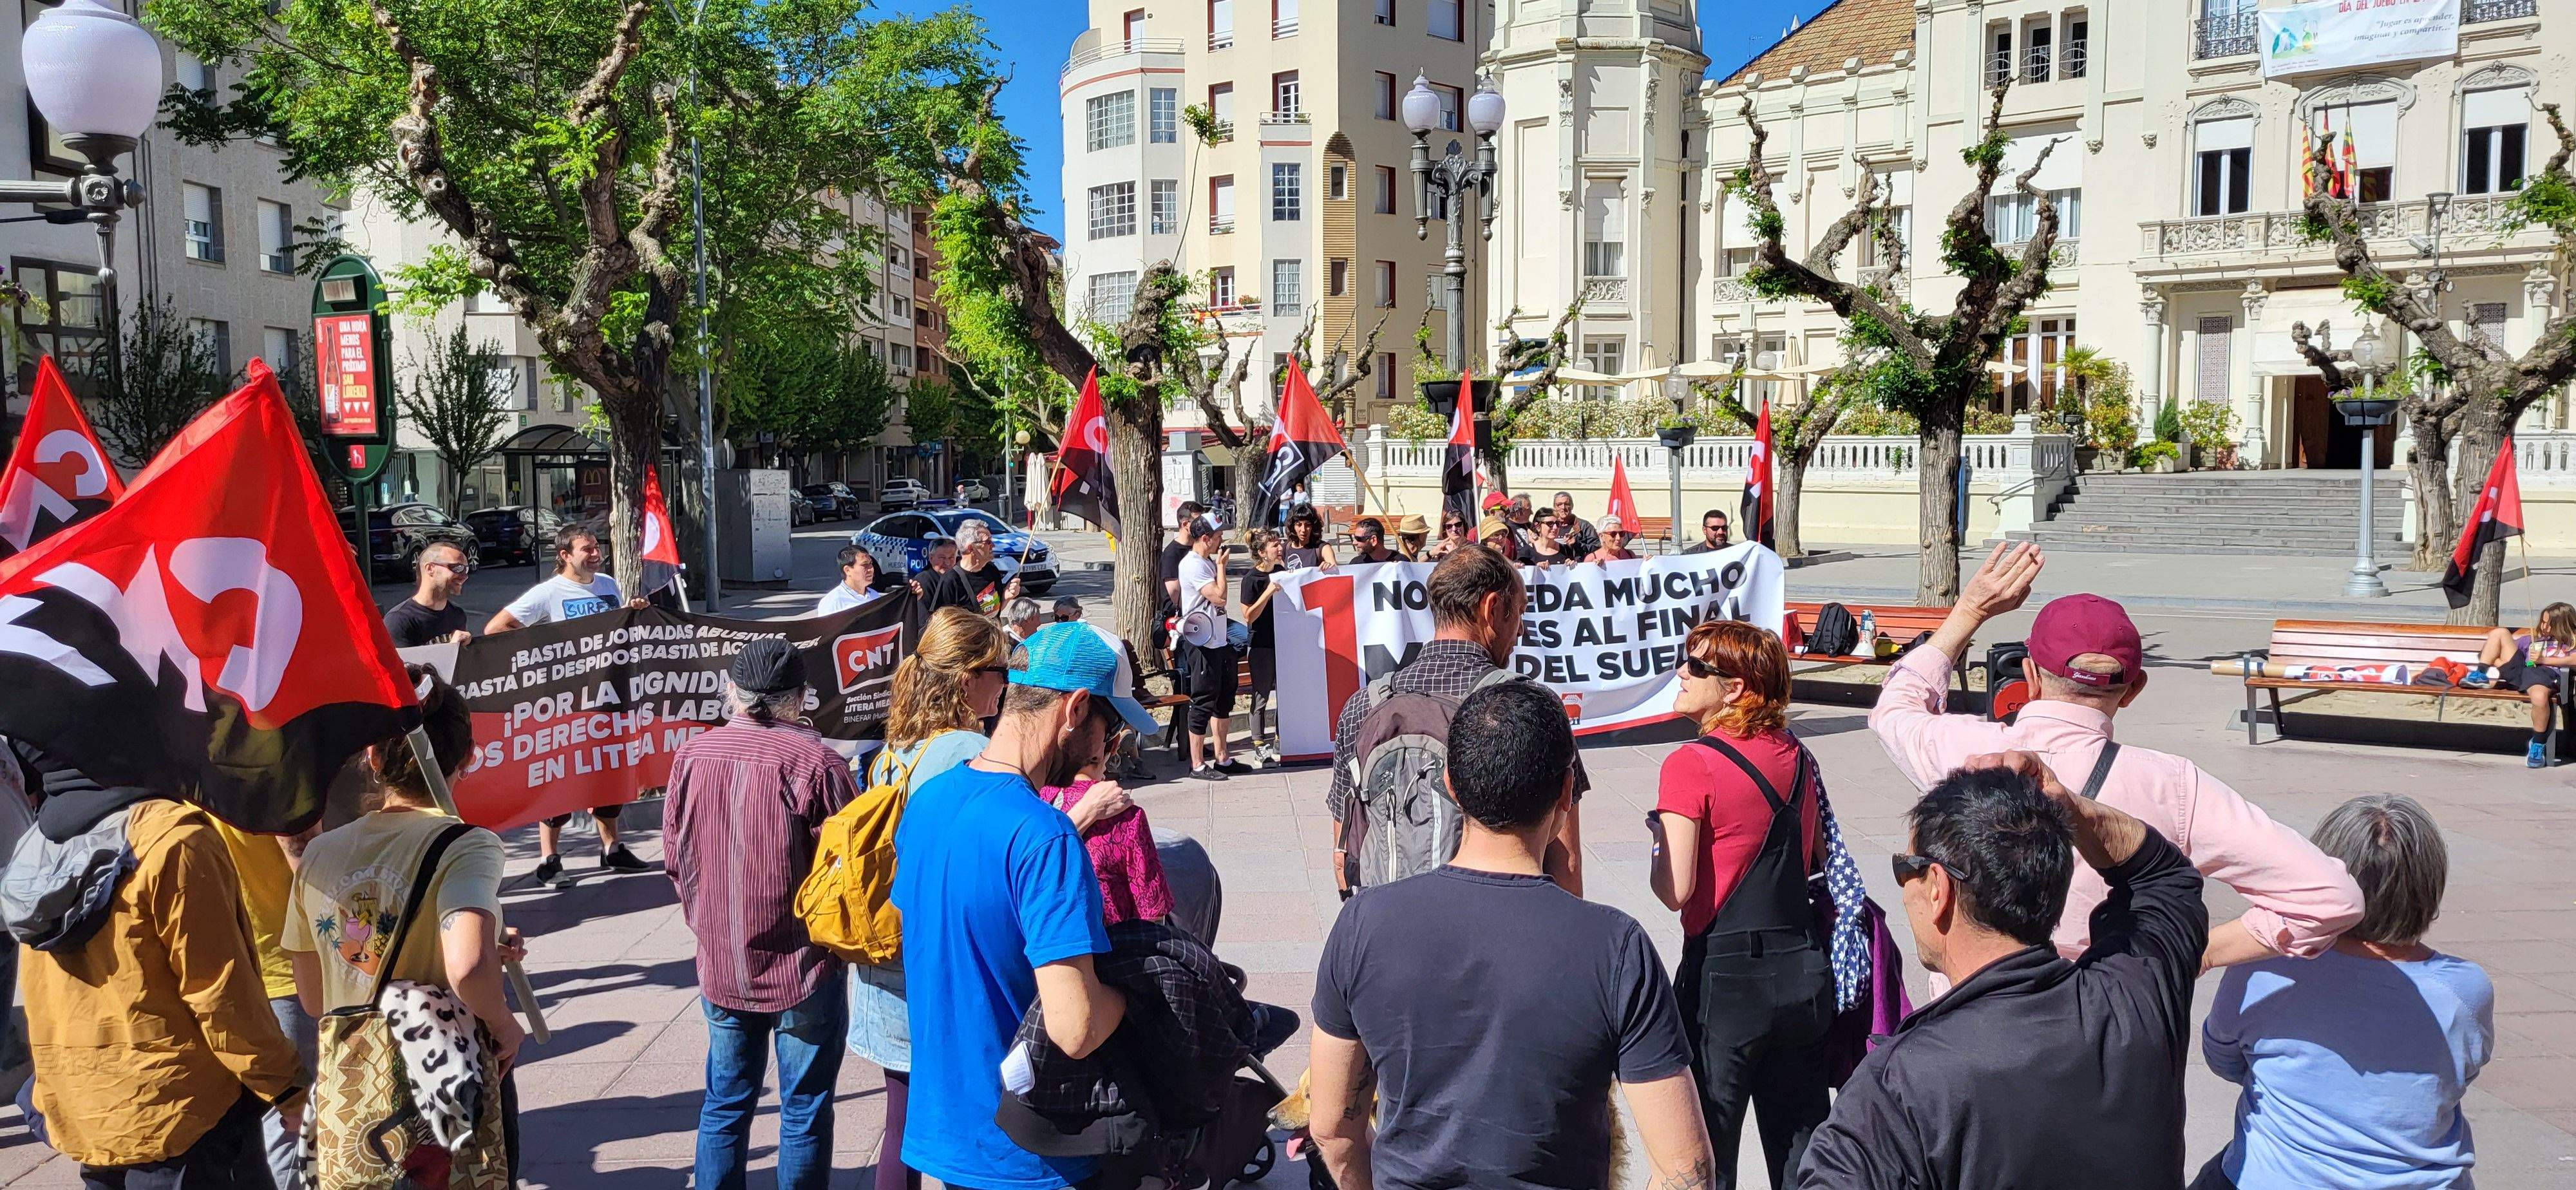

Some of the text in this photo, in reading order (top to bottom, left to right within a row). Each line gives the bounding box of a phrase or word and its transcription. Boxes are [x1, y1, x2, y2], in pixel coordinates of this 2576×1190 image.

[2339, 3, 2351, 13] DÍA
[2356, 1, 2369, 10] DEL
[339, 319, 367, 332] UNA HORA
[340, 334, 359, 346] MENOS
[341, 347, 364, 359] PARA EL
[342, 359, 366, 372] PRÓXIMO
[343, 373, 354, 385] SAN
[343, 385, 366, 398] LORENZO
[1372, 581, 1428, 611] NO
[1604, 561, 1747, 608] MUCHO
[567, 602, 607, 617] SURF
[1573, 616, 1627, 647] AL
[1637, 596, 1751, 641] FINAL
[511, 641, 576, 673] ¡BASTA
[580, 634, 603, 653] DE
[605, 624, 694, 648] JORNADAS
[522, 668, 547, 688] DE
[641, 644, 699, 659] BASTA
[701, 641, 719, 657] DE
[848, 642, 895, 672] CNT
[1300, 575, 1360, 742] 1
[1515, 654, 1590, 683] DEL
[504, 669, 733, 737] ¡POR LA DIGNIDA
[846, 693, 872, 704] Sección
[844, 702, 874, 713] LITERA
[844, 713, 871, 723] BINÉFAR
[466, 741, 504, 773] OS
[527, 755, 565, 788] EN
